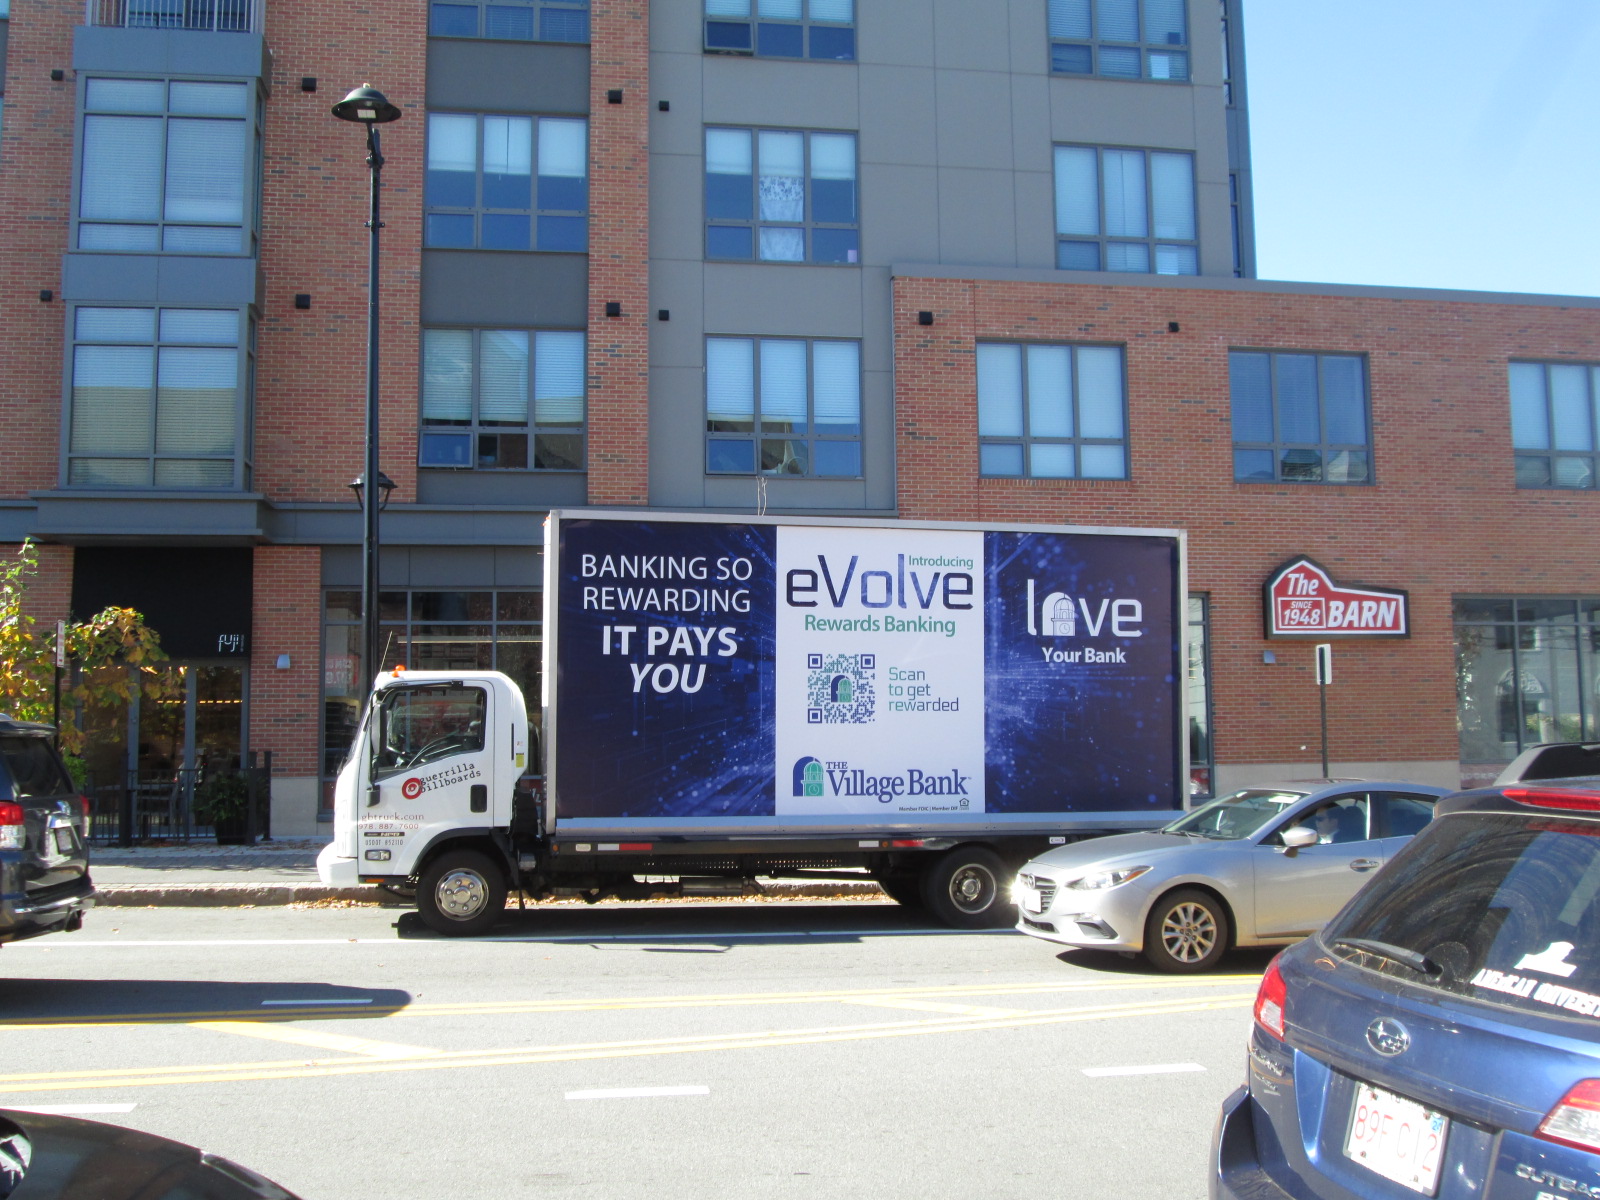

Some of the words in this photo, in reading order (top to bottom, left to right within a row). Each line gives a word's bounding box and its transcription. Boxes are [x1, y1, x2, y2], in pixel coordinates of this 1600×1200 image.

[582, 553, 708, 580] BANKING
[716, 557, 753, 581] SO
[908, 555, 974, 570] Introducing
[786, 553, 974, 610] eVolve
[1287, 573, 1319, 595] The
[583, 586, 751, 613] REWARDING
[1290, 601, 1313, 609] SINCE
[1283, 608, 1321, 625] 1948
[1327, 600, 1397, 628] BARN
[804, 614, 881, 632] Rewards
[884, 615, 956, 637] Banking
[602, 625, 637, 656] IT
[647, 626, 738, 657] PAYS
[1041, 646, 1082, 663] Your
[1084, 647, 1127, 663] Bank
[630, 663, 707, 693] YOU
[888, 666, 925, 681] Scan
[888, 683, 903, 696] to
[907, 683, 931, 700] get
[888, 697, 959, 712] rewarded
[419, 762, 476, 786] guerrilla
[826, 761, 848, 770] THE
[419, 769, 482, 794] billboards
[826, 769, 905, 803] Village
[907, 769, 968, 796] Bank
[361, 812, 425, 822] gbtruck.com
